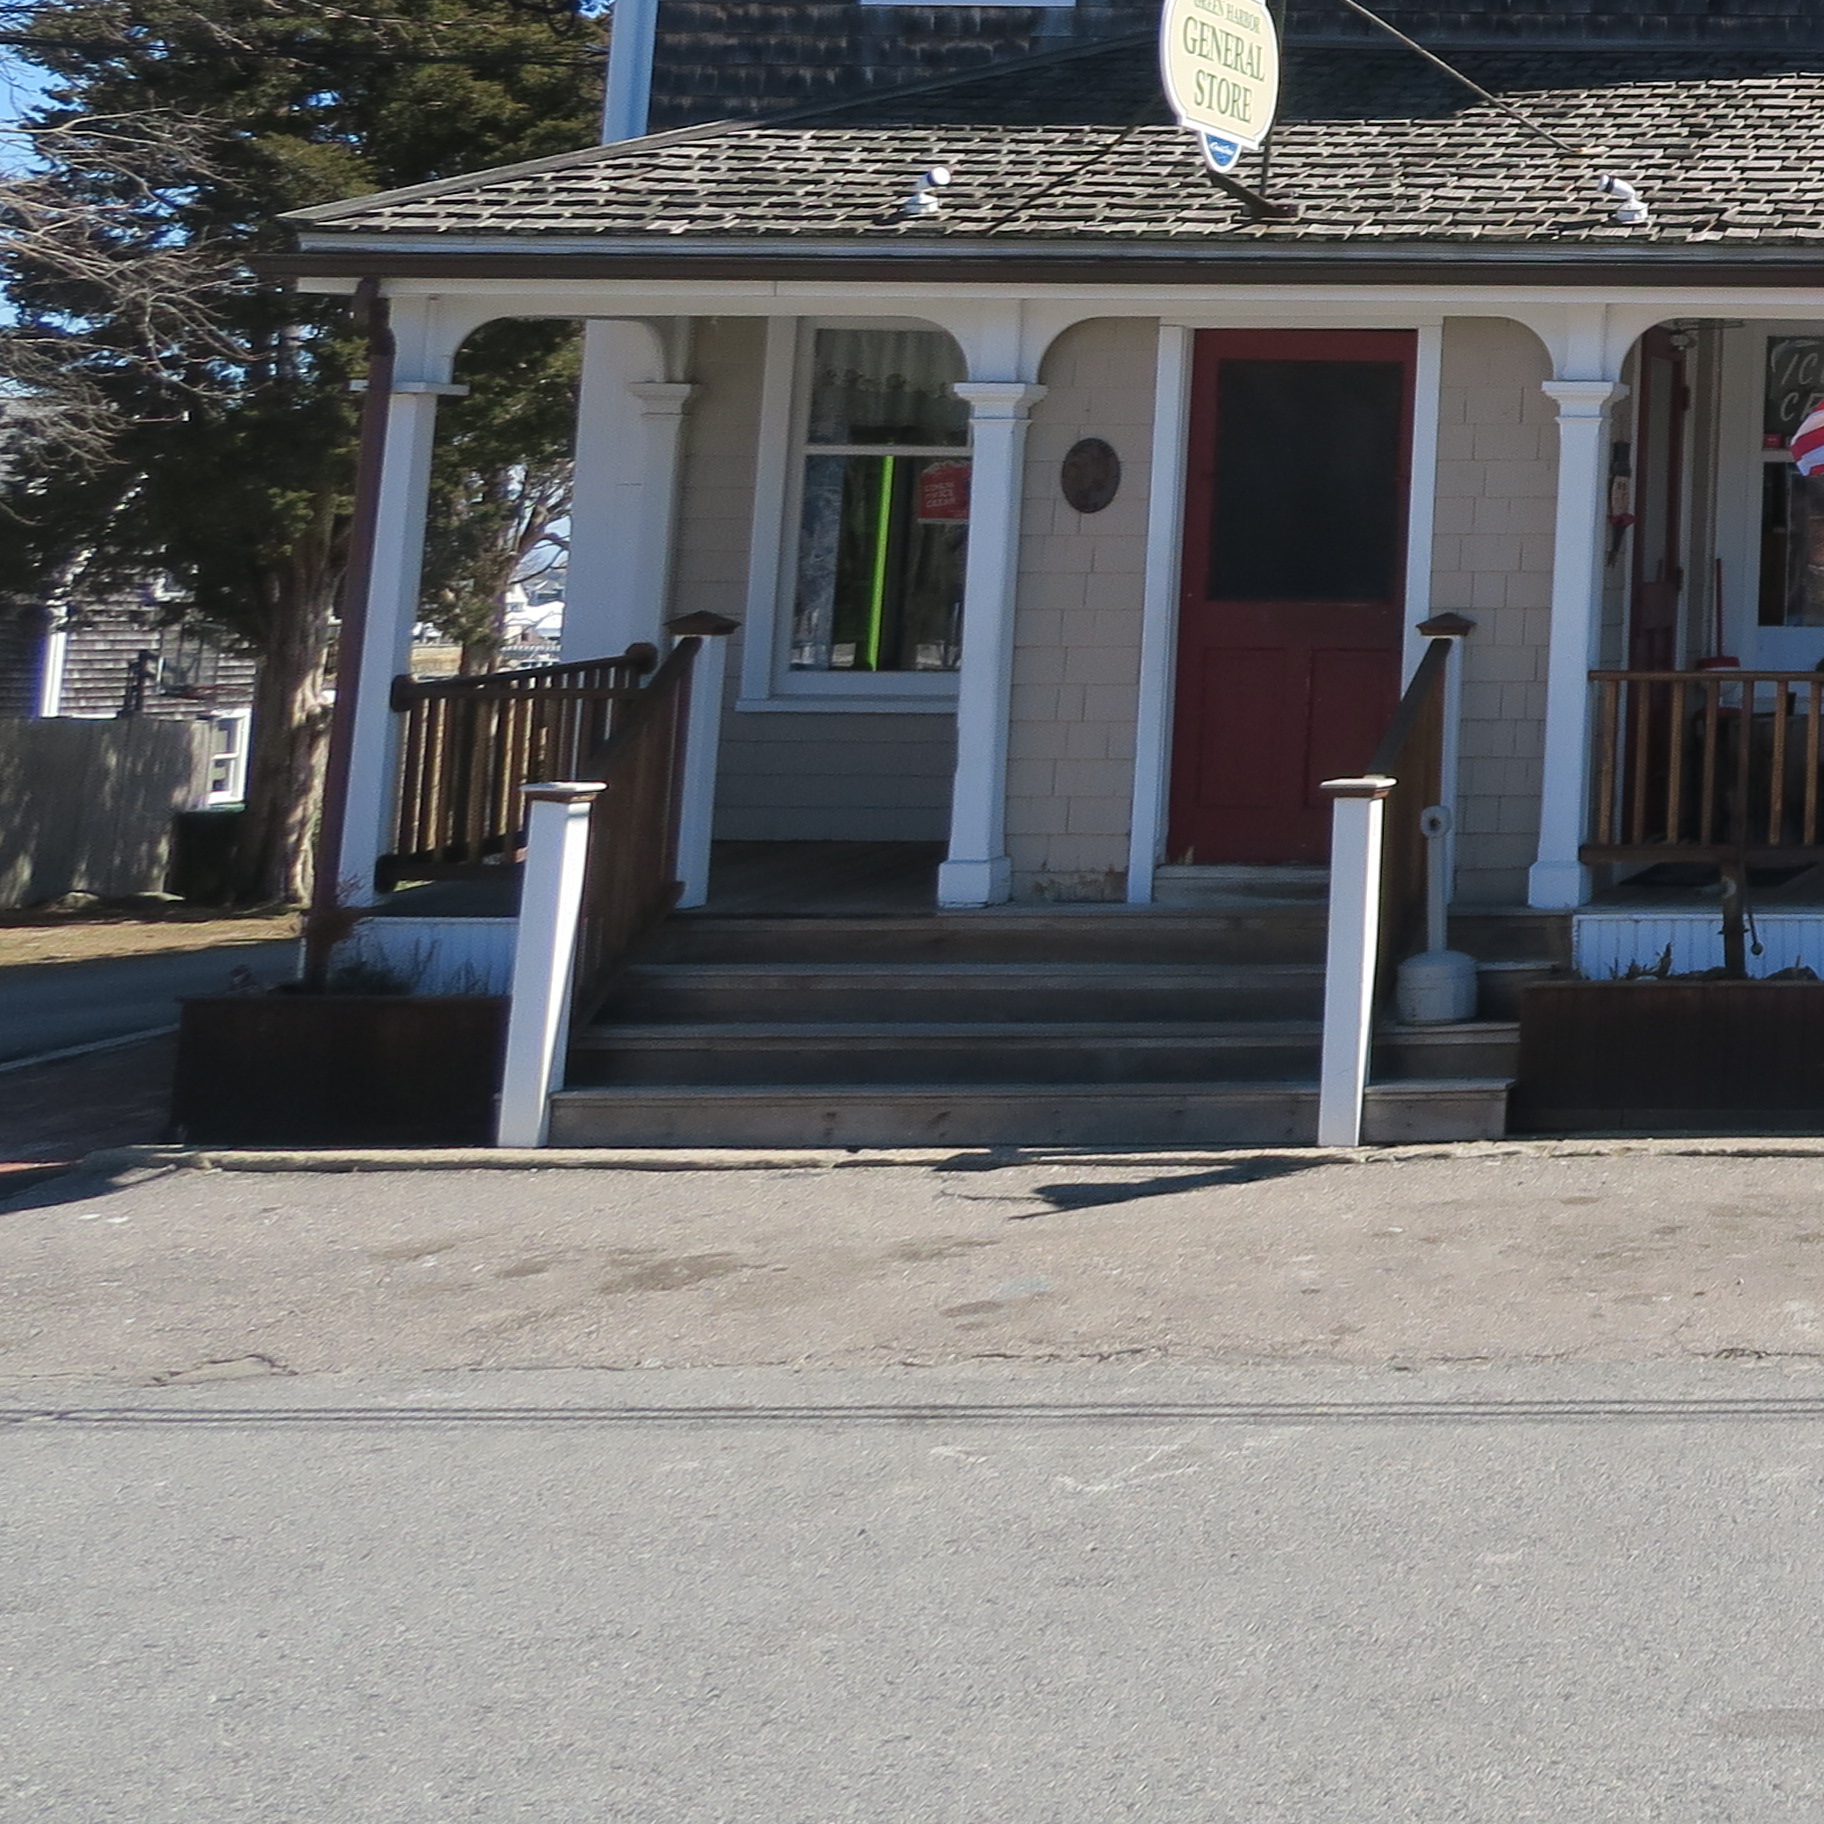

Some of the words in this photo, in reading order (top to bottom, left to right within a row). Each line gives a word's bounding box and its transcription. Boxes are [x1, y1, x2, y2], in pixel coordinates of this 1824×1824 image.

[1226, 2, 1261, 34] HARBOR
[1183, 16, 1265, 82] GENERAL
[1194, 69, 1252, 124] STORE
